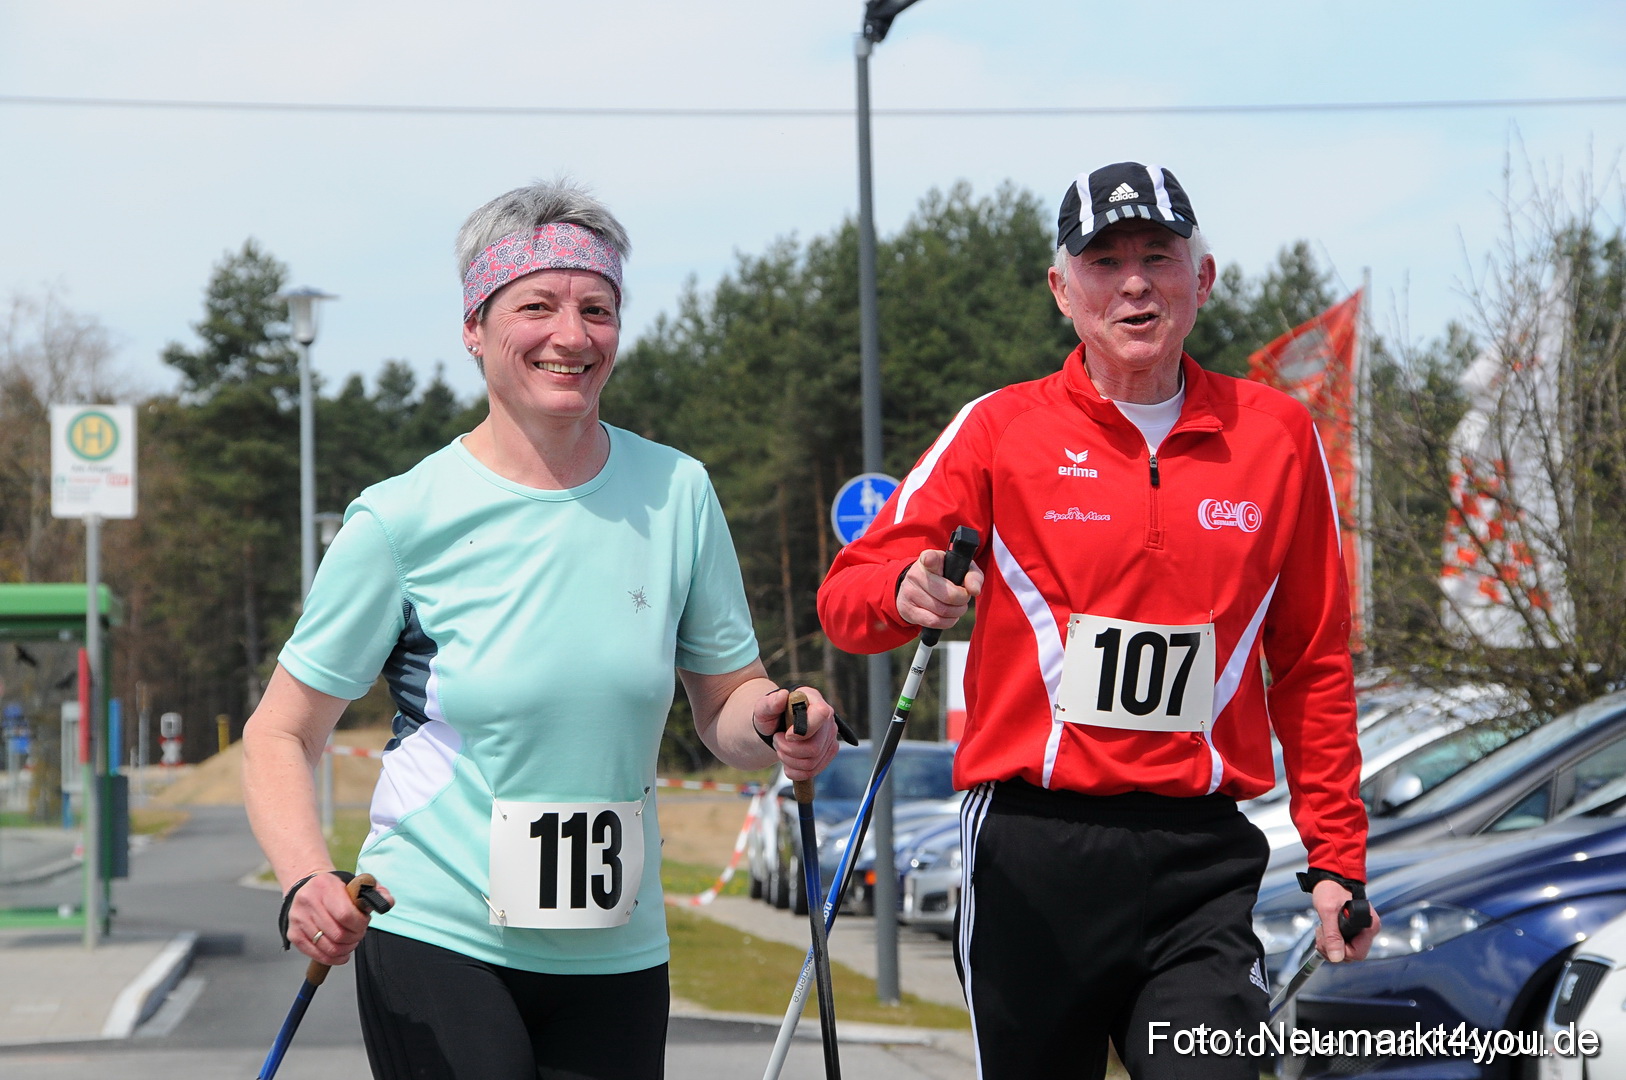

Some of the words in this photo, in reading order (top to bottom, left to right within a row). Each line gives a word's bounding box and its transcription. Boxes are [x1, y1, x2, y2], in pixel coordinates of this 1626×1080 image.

[1108, 191, 1140, 203] adidas
[1058, 463, 1098, 479] erima
[1094, 627, 1201, 717] 107
[529, 810, 623, 911] 113
